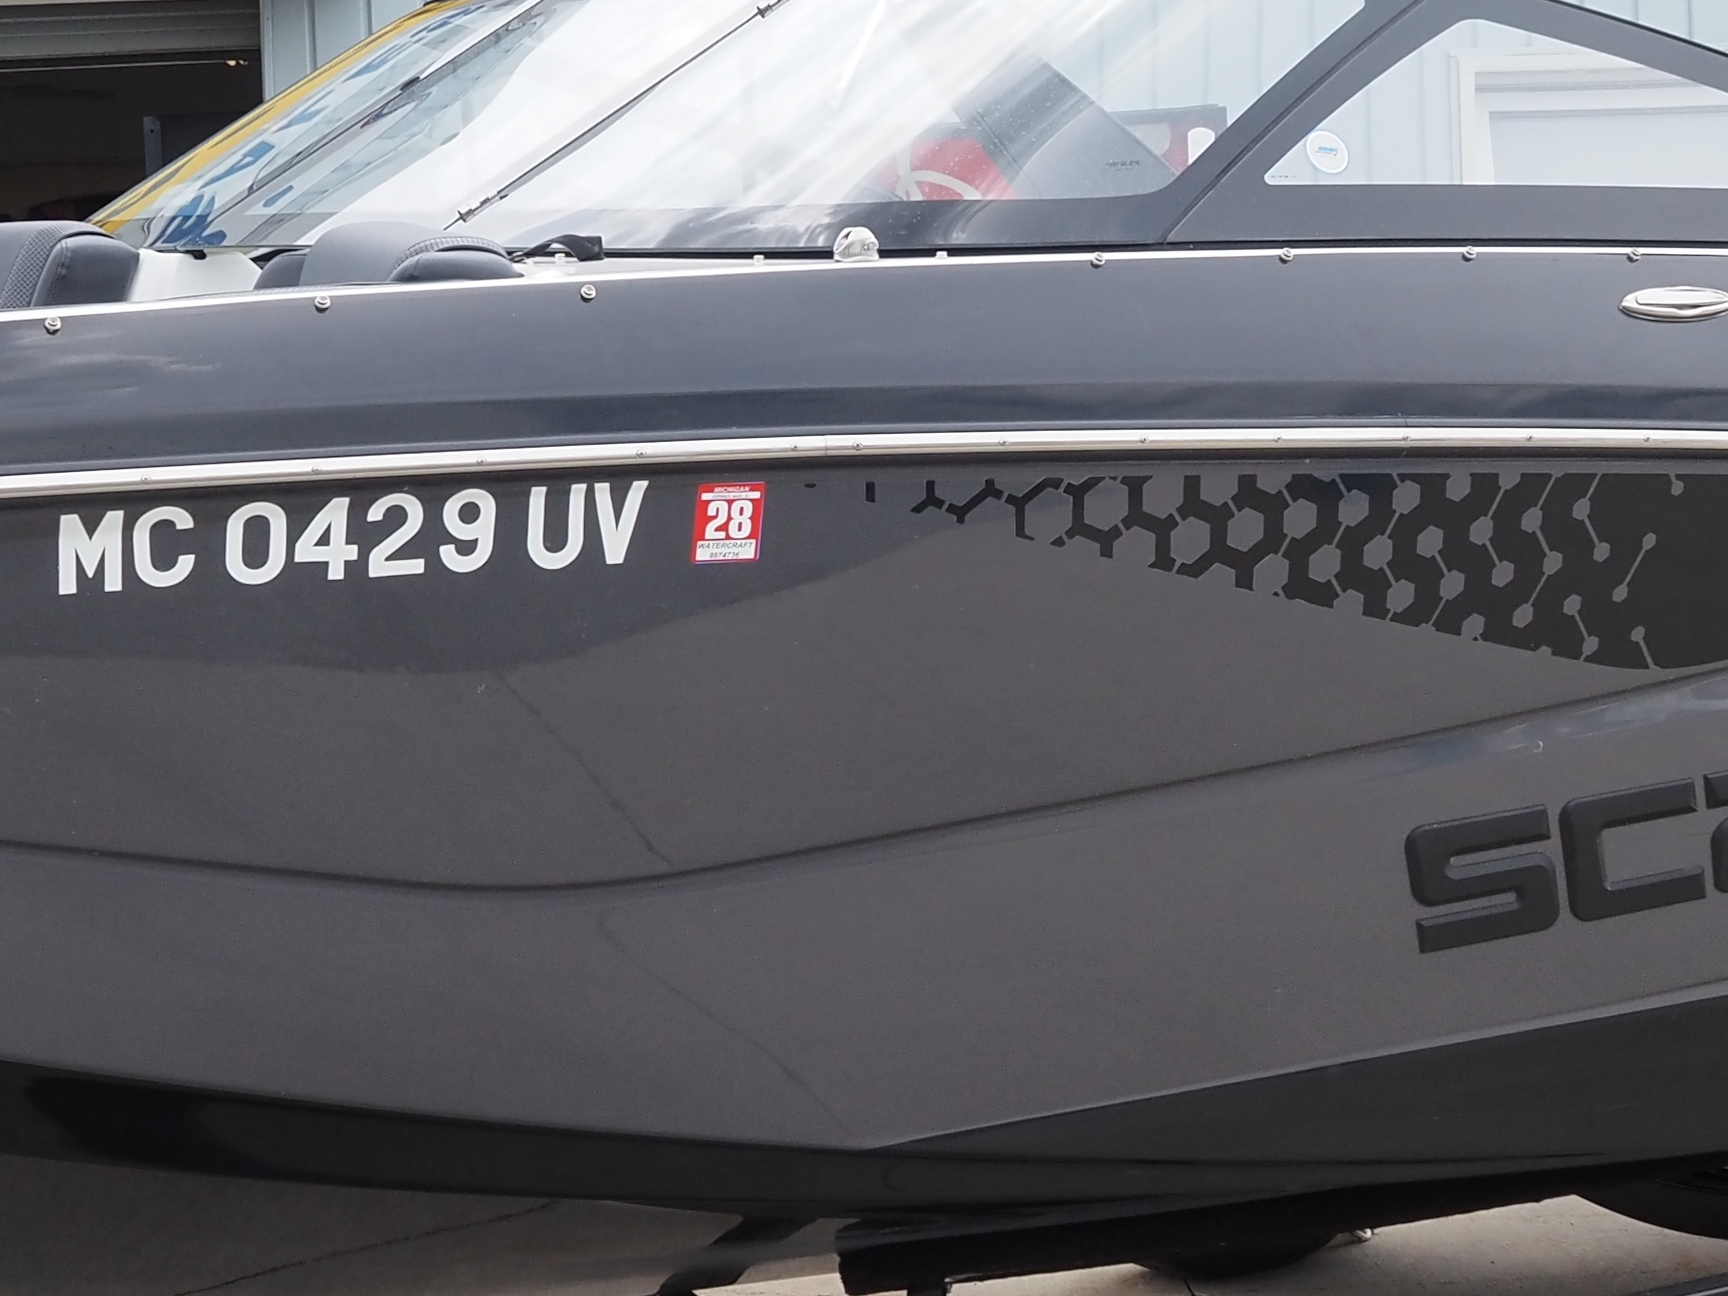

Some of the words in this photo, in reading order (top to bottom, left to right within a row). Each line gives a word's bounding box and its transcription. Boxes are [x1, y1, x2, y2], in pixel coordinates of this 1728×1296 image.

[58, 506, 196, 596] MC
[225, 488, 497, 585] 0429
[526, 480, 649, 571] UV
[704, 499, 753, 540] 28
[698, 541, 753, 550] WATERCRAFT
